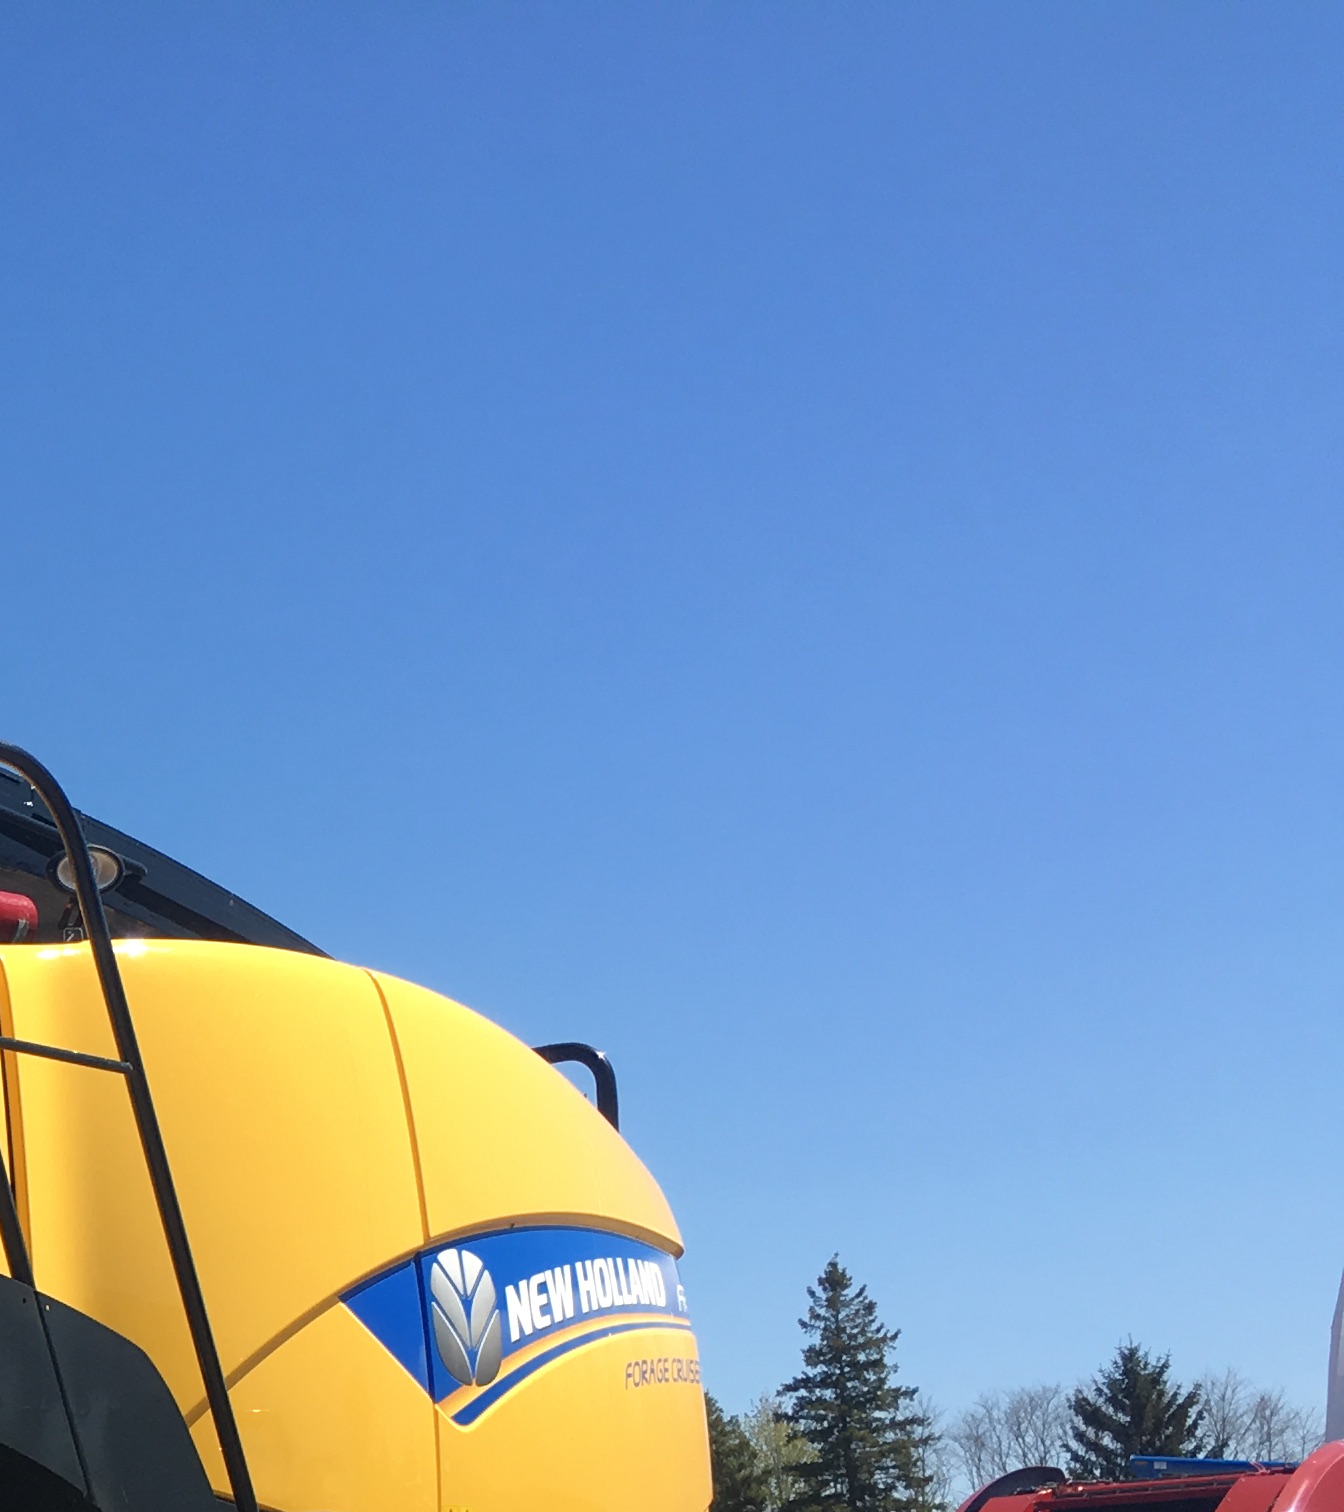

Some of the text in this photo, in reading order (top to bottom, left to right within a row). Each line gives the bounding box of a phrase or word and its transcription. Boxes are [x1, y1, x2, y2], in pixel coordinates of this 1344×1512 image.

[505, 1264, 574, 1343] NEW
[575, 1257, 667, 1314] HOLLAND
[625, 1357, 700, 1391] FORAGE CRUISE
